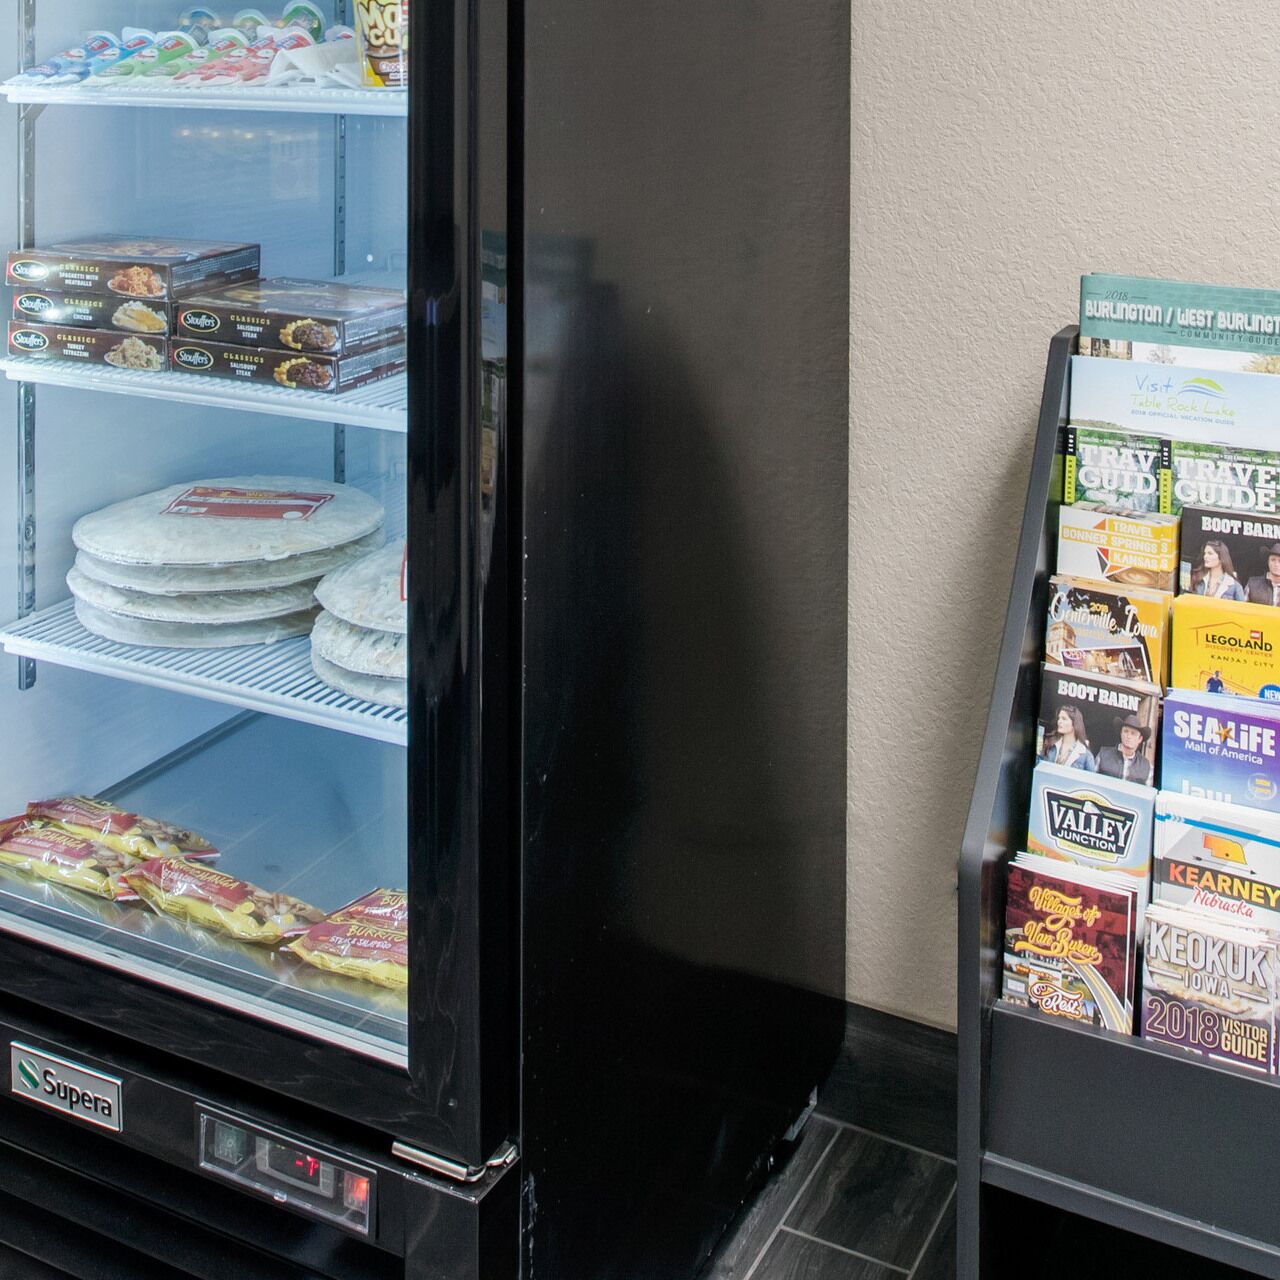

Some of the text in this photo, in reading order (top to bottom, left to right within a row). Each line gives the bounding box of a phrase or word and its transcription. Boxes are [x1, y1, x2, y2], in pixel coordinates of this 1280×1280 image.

[65, 279, 92, 287] MEATBALLS
[64, 299, 102, 307] CLASSICS
[1105, 290, 1128, 301] 2018
[186, 314, 215, 328] Stouffer's
[230, 315, 270, 325] CLASSICS
[1086, 300, 1163, 325] BURLINGTON
[1177, 308, 1213, 329] WEST
[237, 324, 263, 332] SALISBURY
[16, 335, 44, 347] Stouffer's
[57, 334, 96, 343] CLASSICS
[1180, 330, 1280, 346] COMMUNITY GUIDE
[179, 351, 208, 365] Stouffer's
[223, 353, 264, 363] CLASSICS
[230, 362, 256, 371] SALISBURY
[1174, 480, 1276, 512] GUIDE
[1201, 516, 1241, 536] BOOT
[1210, 654, 1274, 669] KANSAS CITY
[1058, 679, 1141, 712] BOOT BARN
[1185, 741, 1263, 765] Mall of America
[1051, 801, 1132, 847] VALLEY
[1058, 830, 1116, 852] JUNCTION
[1149, 921, 1267, 989] KEOKUK
[1184, 970, 1230, 999] IOWA
[1146, 996, 1268, 1048] 2018 VISITOR
[1221, 1032, 1267, 1063] GUIDE
[43, 1069, 113, 1118] Supera
